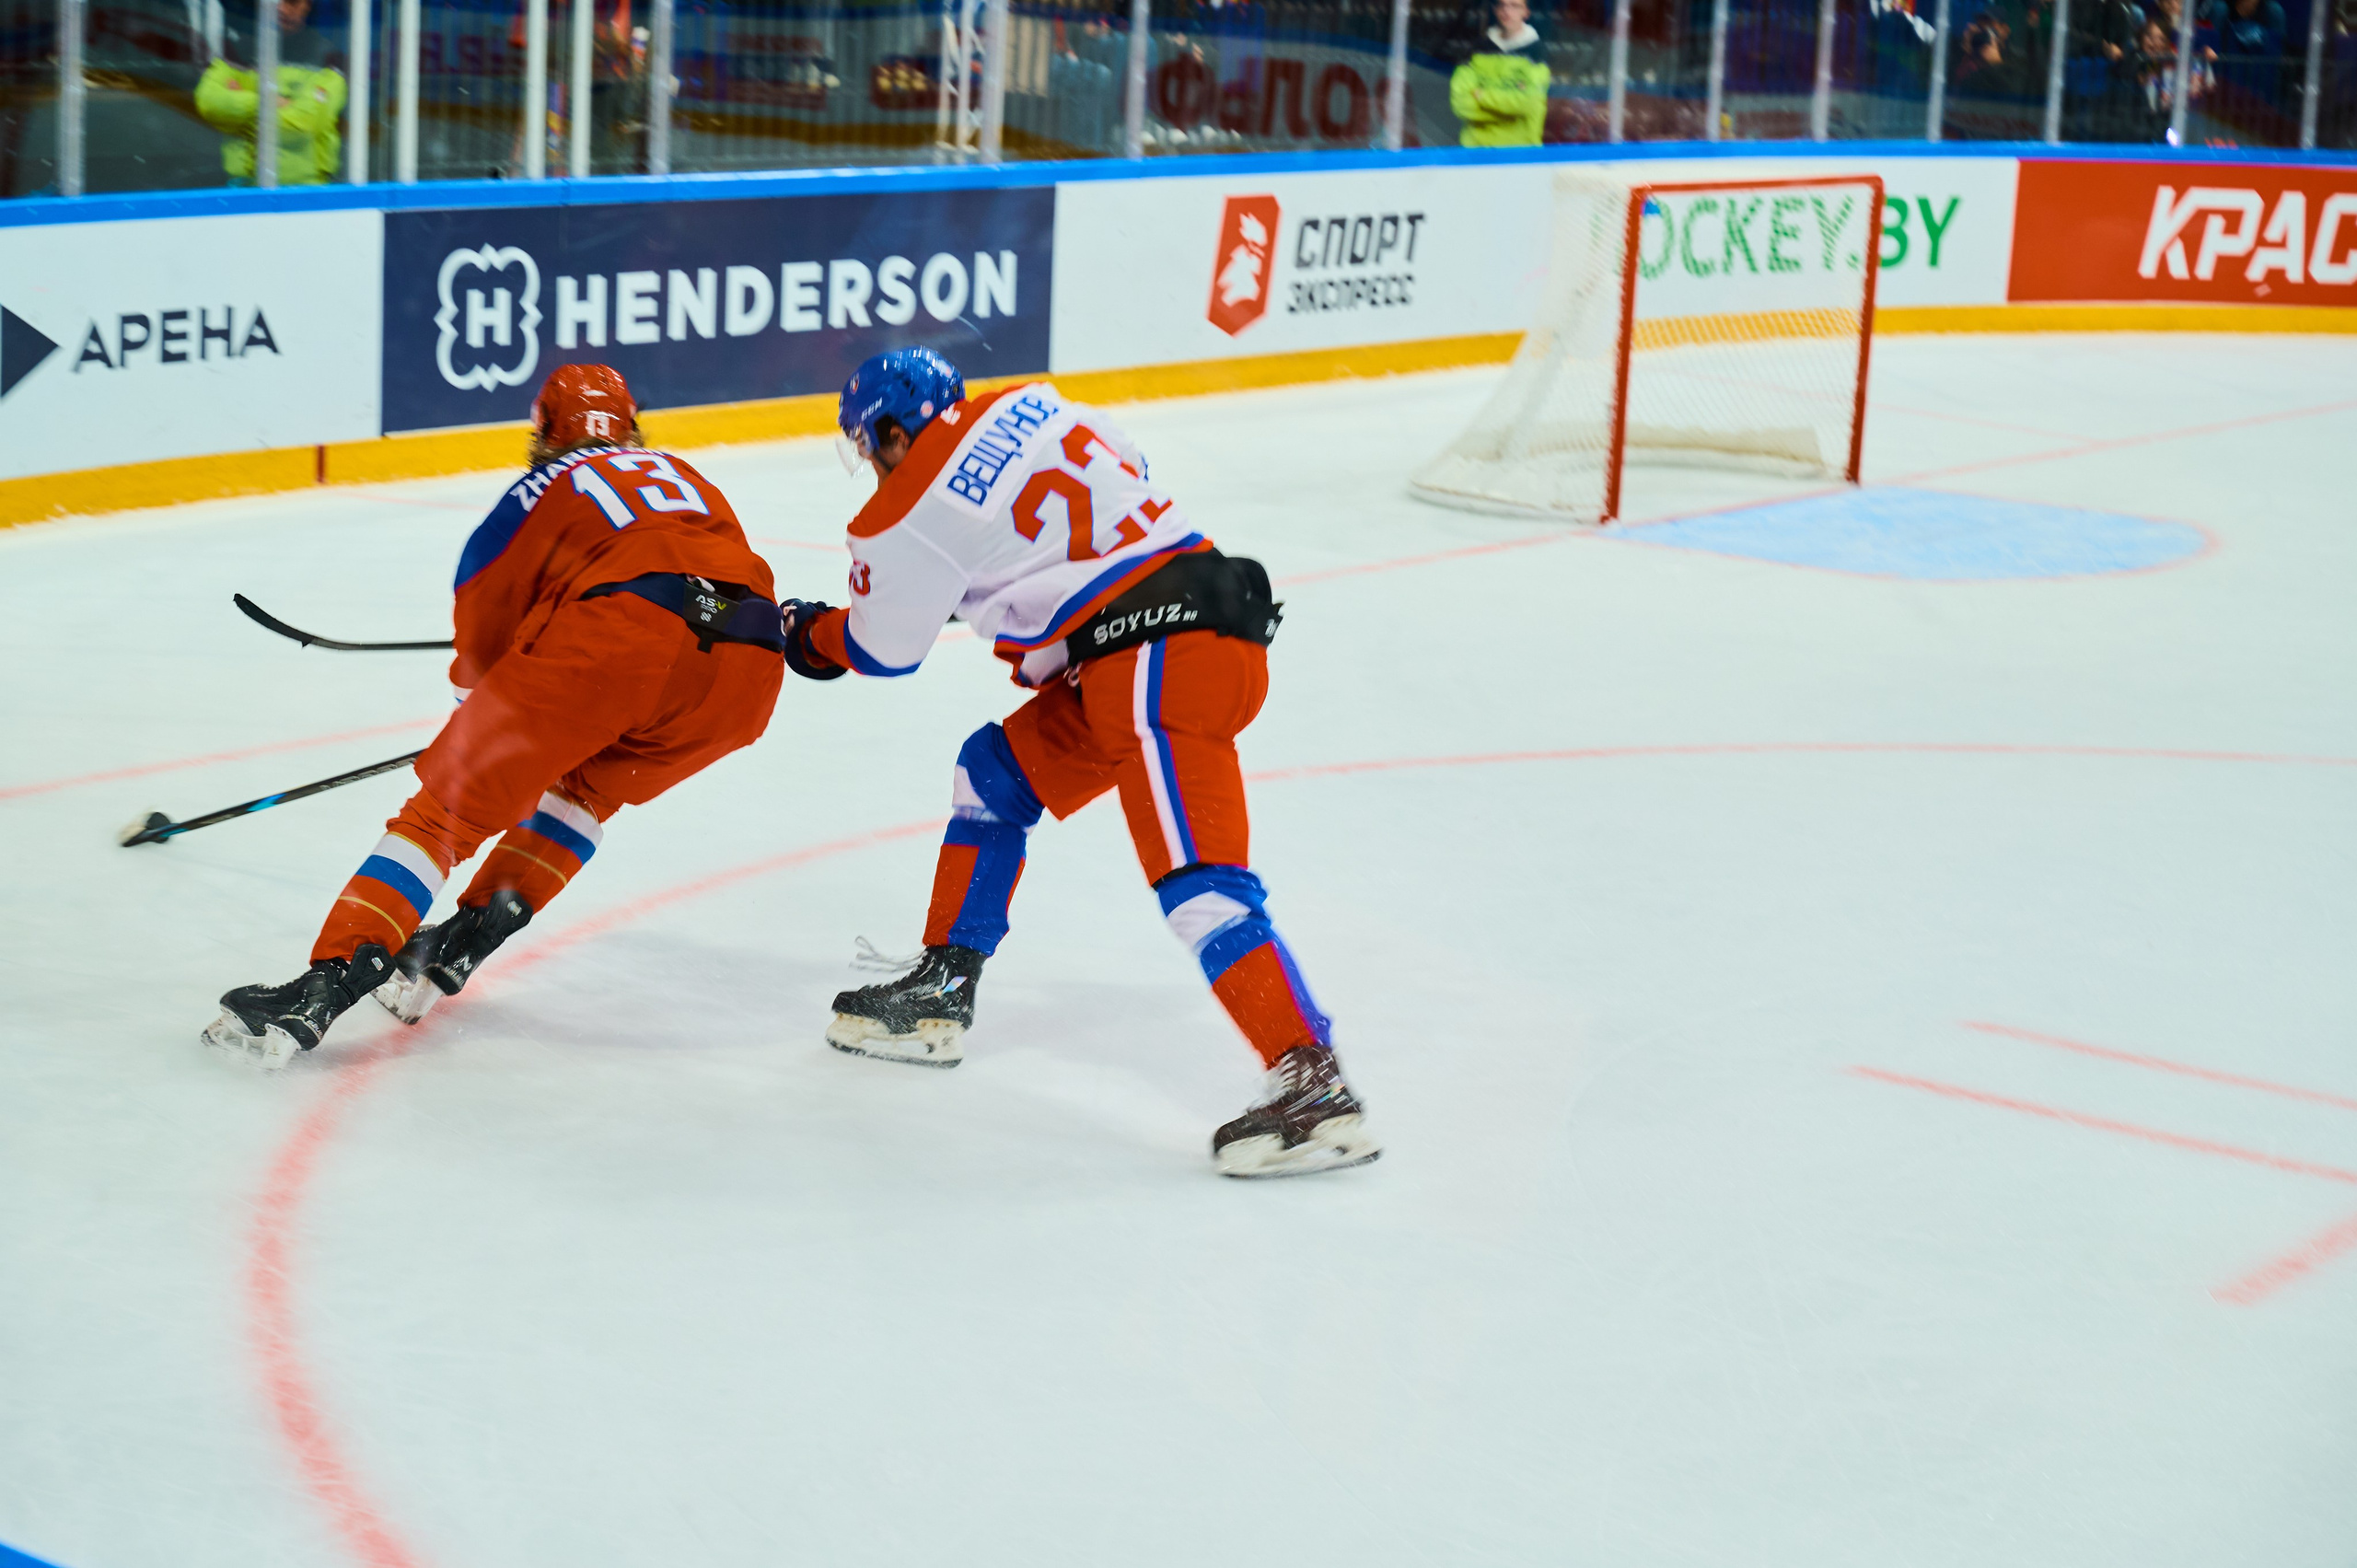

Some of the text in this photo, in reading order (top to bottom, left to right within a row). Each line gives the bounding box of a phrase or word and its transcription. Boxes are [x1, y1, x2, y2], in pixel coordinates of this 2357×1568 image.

[1295, 214, 1425, 269] СПОРТ
[1590, 191, 1962, 282] OCKEY.BY
[2137, 184, 2357, 286] КРАС
[555, 250, 1018, 350] HENDERSON
[1287, 273, 1414, 313] ЭКСПРЕСС
[70, 304, 284, 374] АРЕНА
[585, 412, 611, 438] 13
[568, 453, 712, 532] 13
[848, 558, 871, 597] 3
[1094, 603, 1182, 645] SOYUZ
